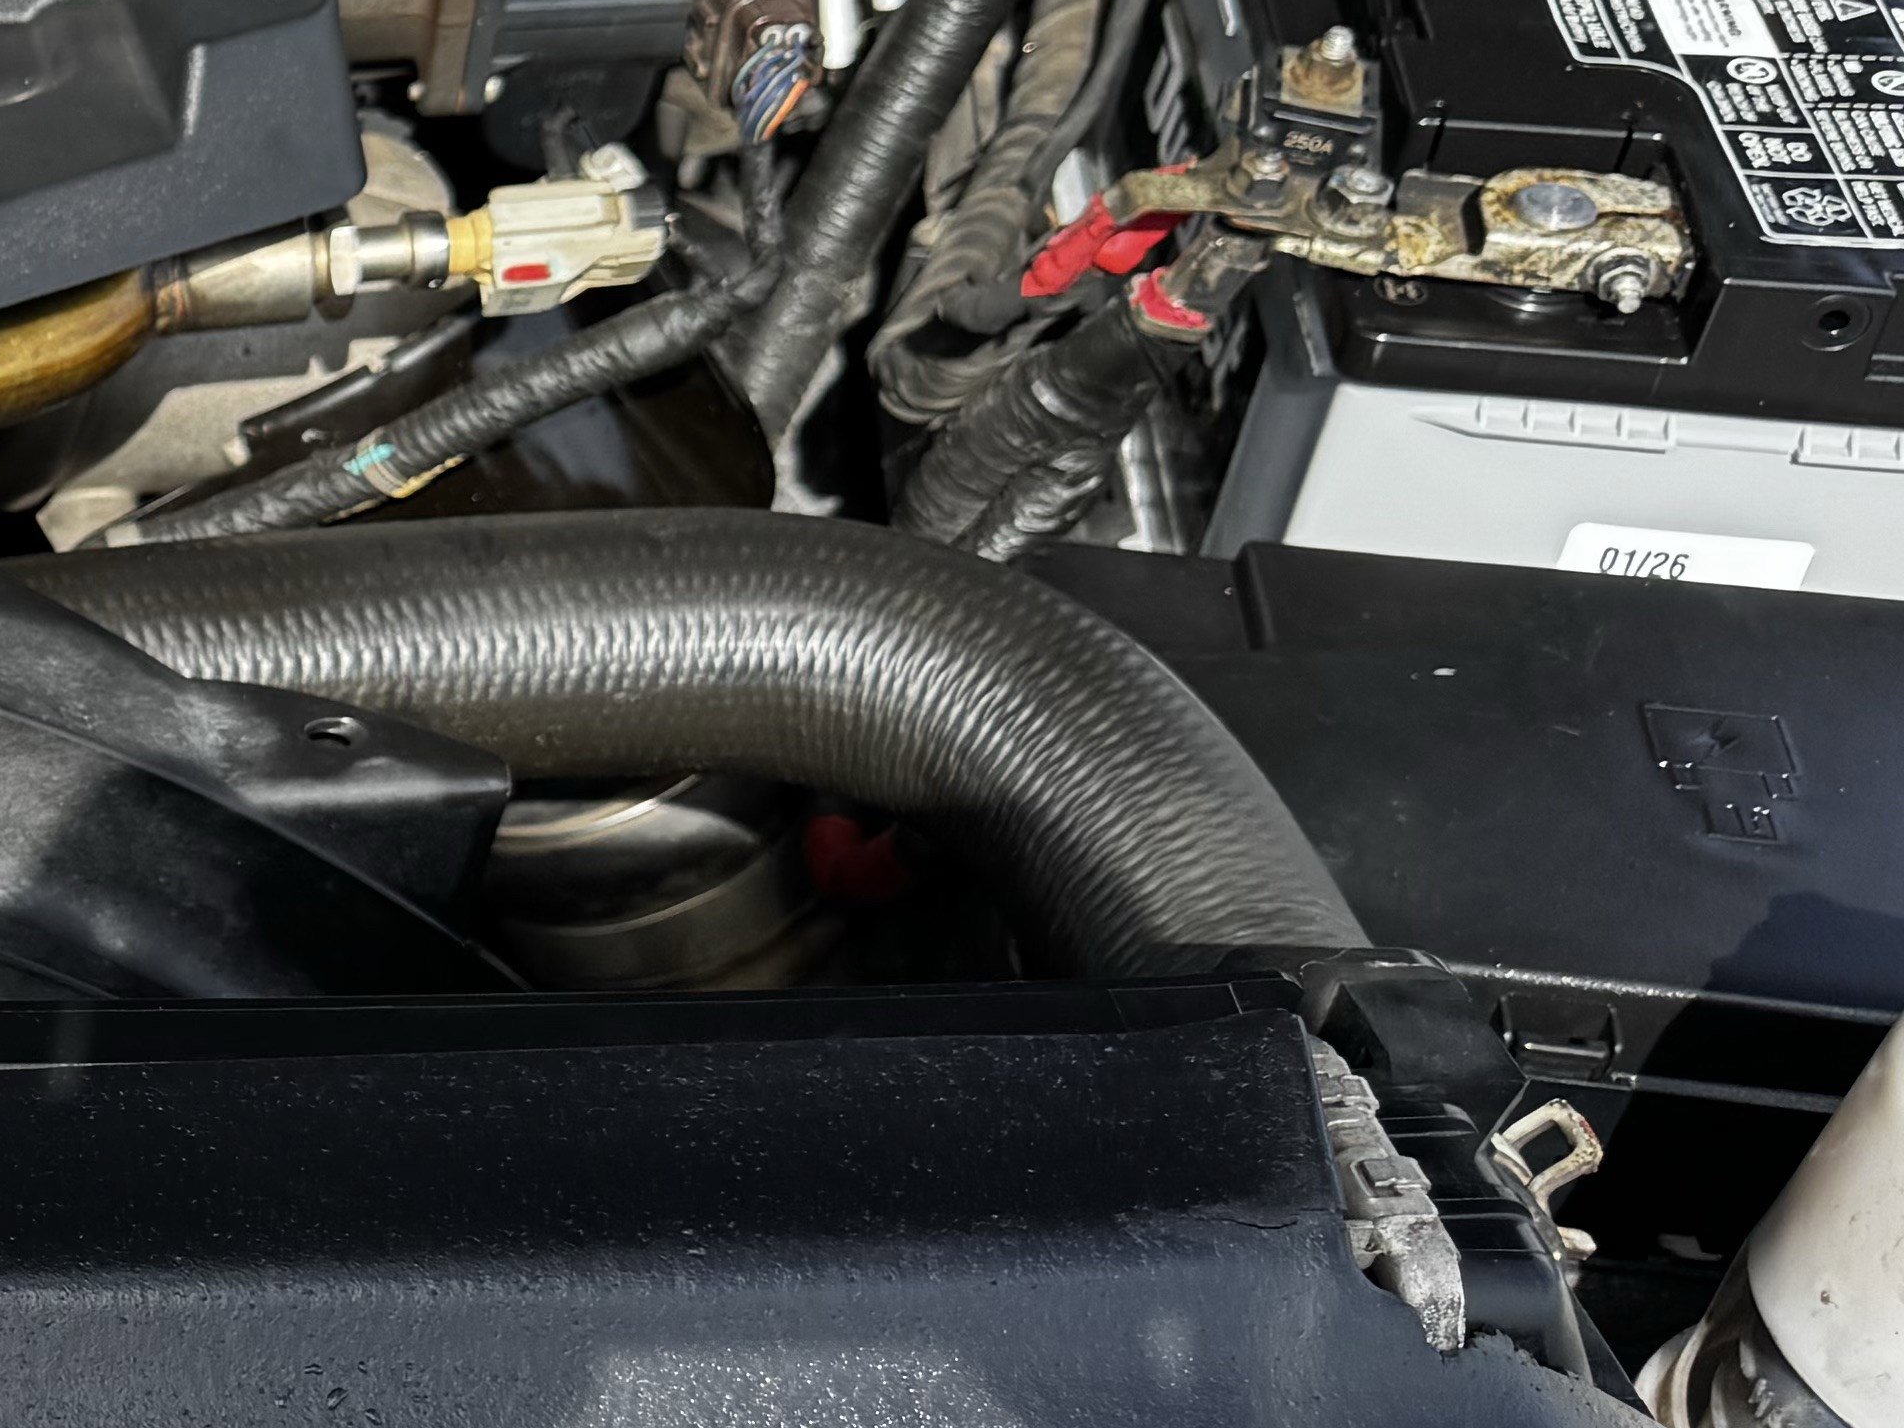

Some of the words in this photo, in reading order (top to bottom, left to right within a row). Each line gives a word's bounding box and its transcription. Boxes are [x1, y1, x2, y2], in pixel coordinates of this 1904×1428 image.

[1283, 130, 1334, 155] 250A
[1763, 138, 1792, 164] NOT
[1599, 546, 1690, 581] 01/26
